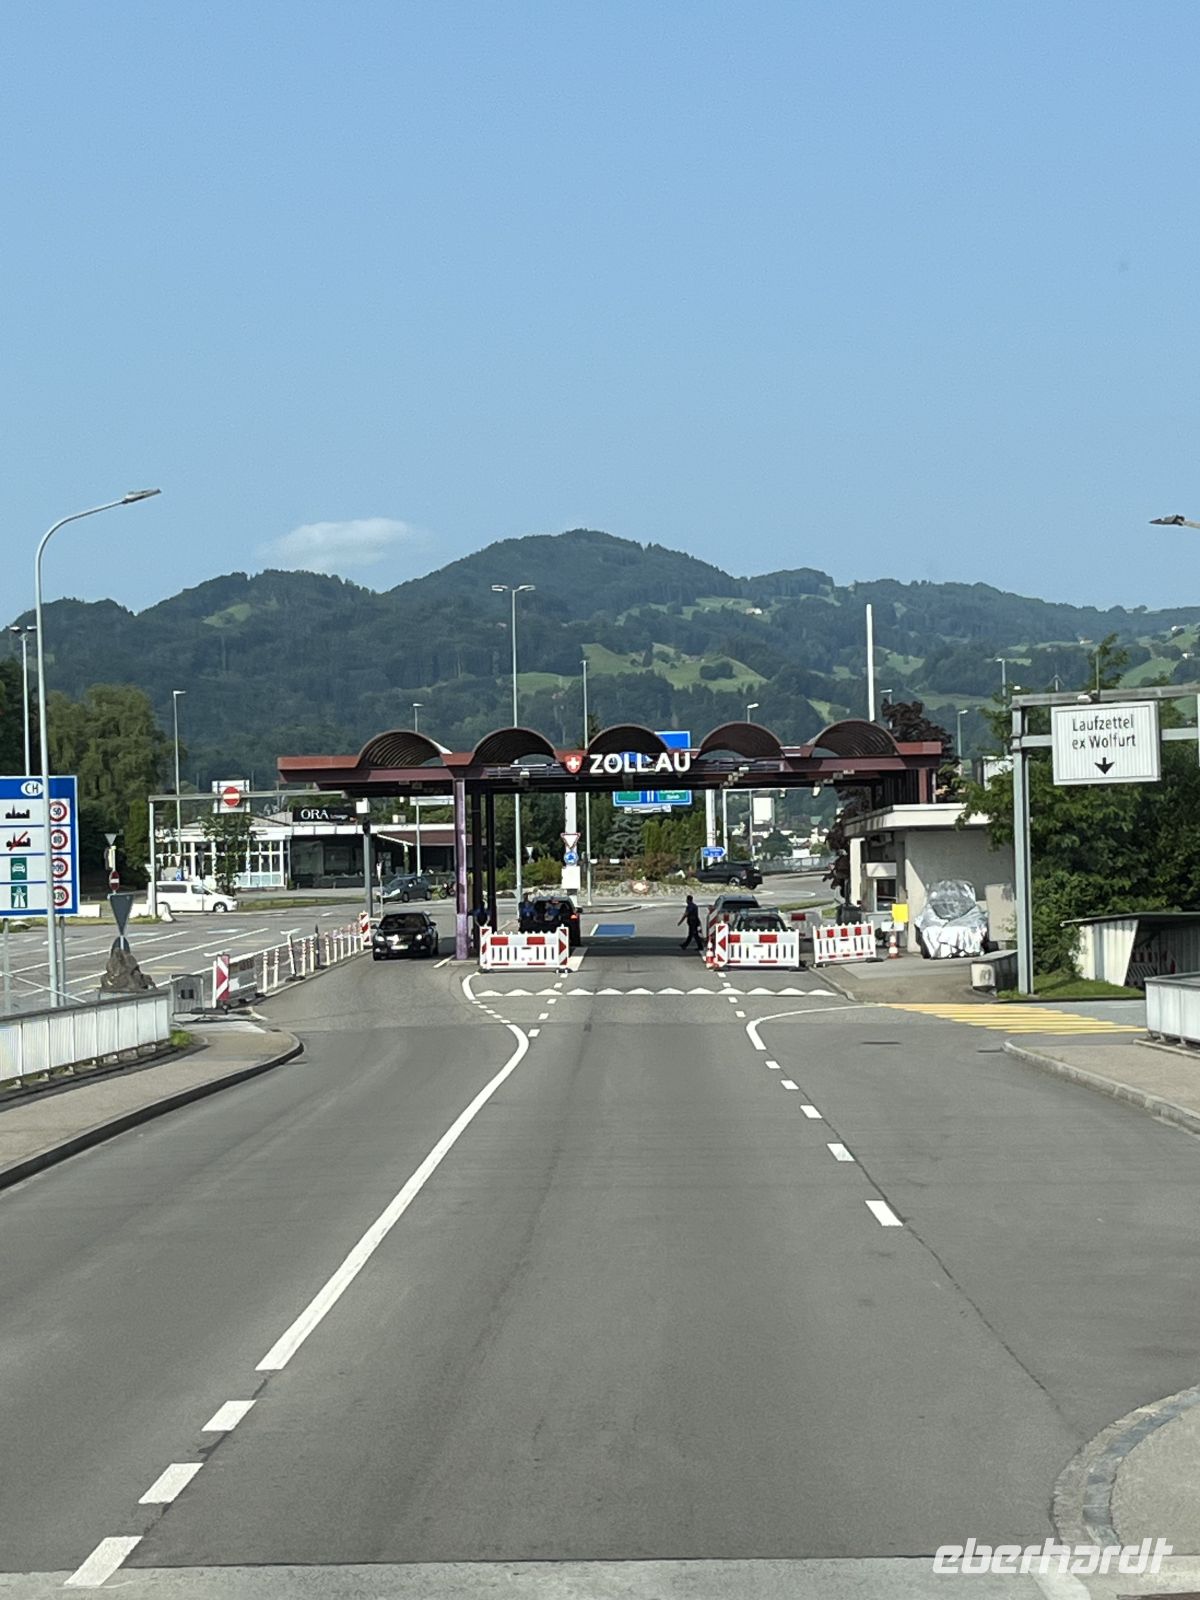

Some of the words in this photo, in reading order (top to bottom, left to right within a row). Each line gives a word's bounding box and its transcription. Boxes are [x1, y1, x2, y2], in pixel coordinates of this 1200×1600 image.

[1072, 714, 1134, 731] Laufzettel
[1072, 739, 1086, 750] ex
[1089, 734, 1136, 748] Wolfurt
[589, 752, 649, 773] ZOLL
[655, 752, 691, 773] AU
[25, 783, 39, 794] CH
[53, 807, 62, 816] 50
[301, 808, 329, 820] ORA
